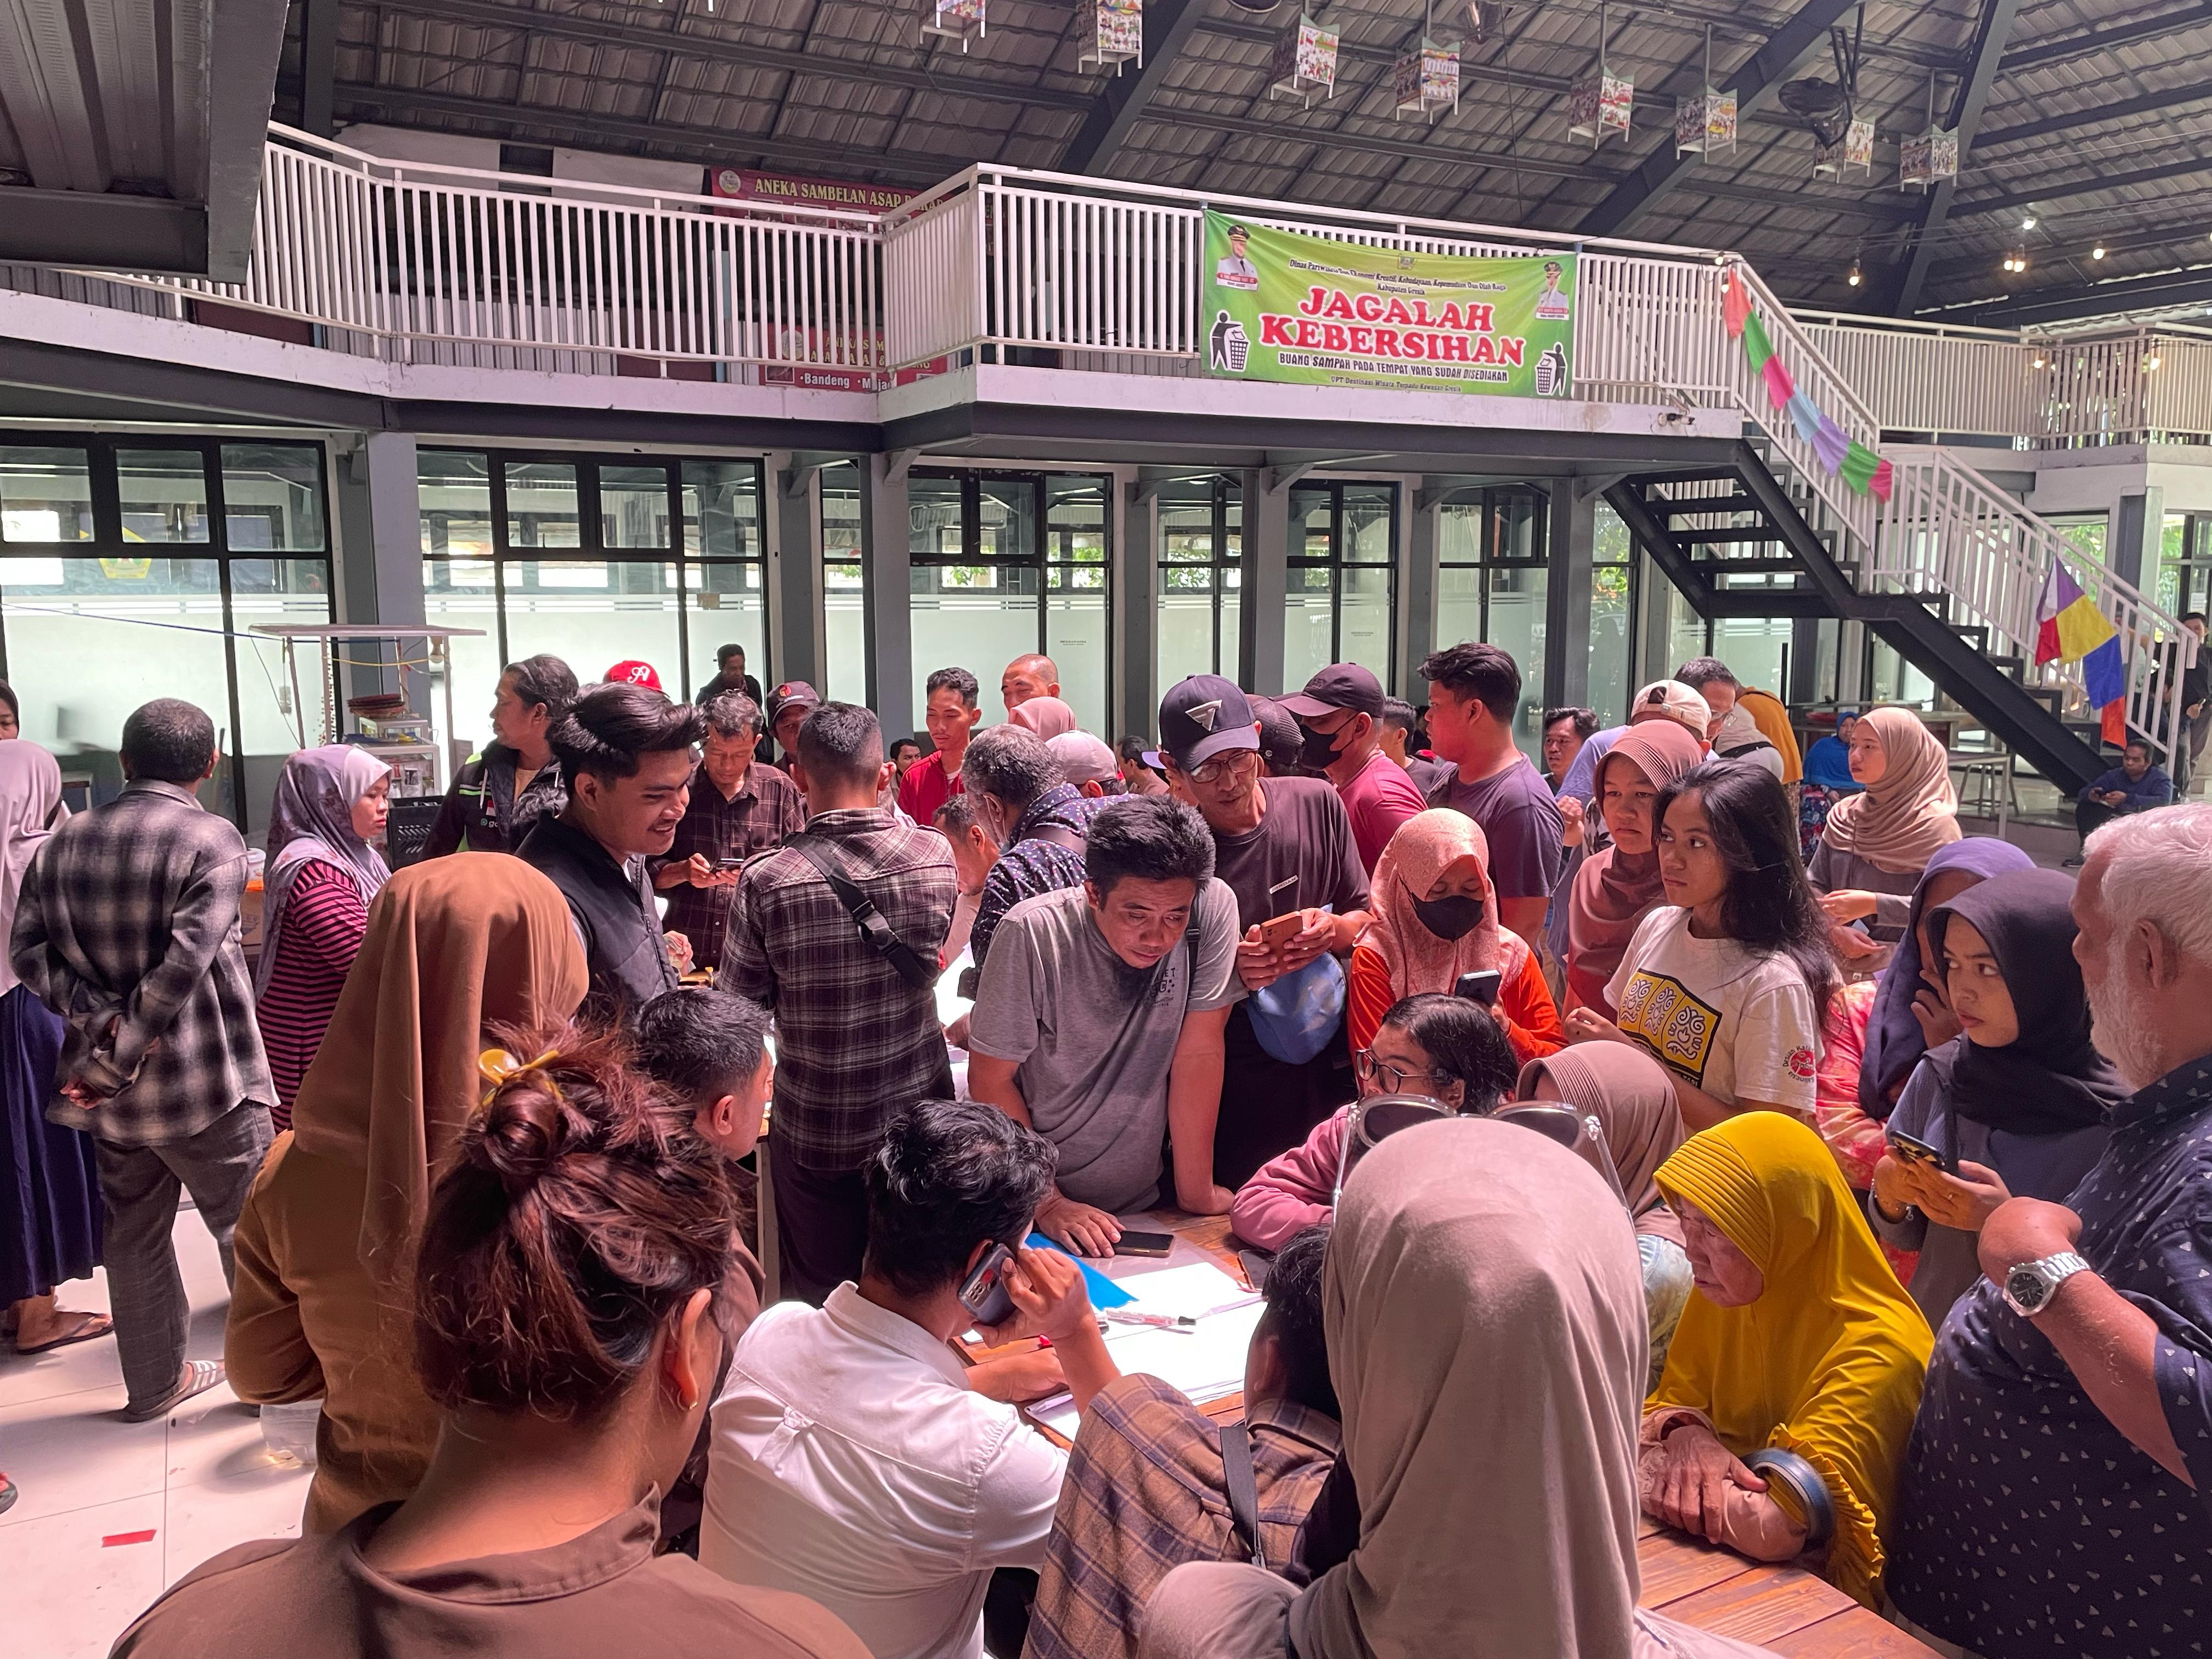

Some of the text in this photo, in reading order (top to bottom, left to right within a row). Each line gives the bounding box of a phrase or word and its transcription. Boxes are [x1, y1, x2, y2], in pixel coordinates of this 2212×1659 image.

[755, 178, 798, 196] ANEKA
[801, 182, 866, 205] SAMBELAN
[869, 191, 901, 208] ASAP
[1300, 287, 1494, 332] JAGALAH
[1261, 315, 1526, 365] KEBERSIHAN
[804, 373, 850, 389] Bandeng
[1279, 353, 1508, 381] BUANG SAMPAH PADA TEMPAT YANG SUDAH DISEDIAKAN
[1345, 377, 1373, 386] Destinasi
[1375, 379, 1395, 387] Wisata
